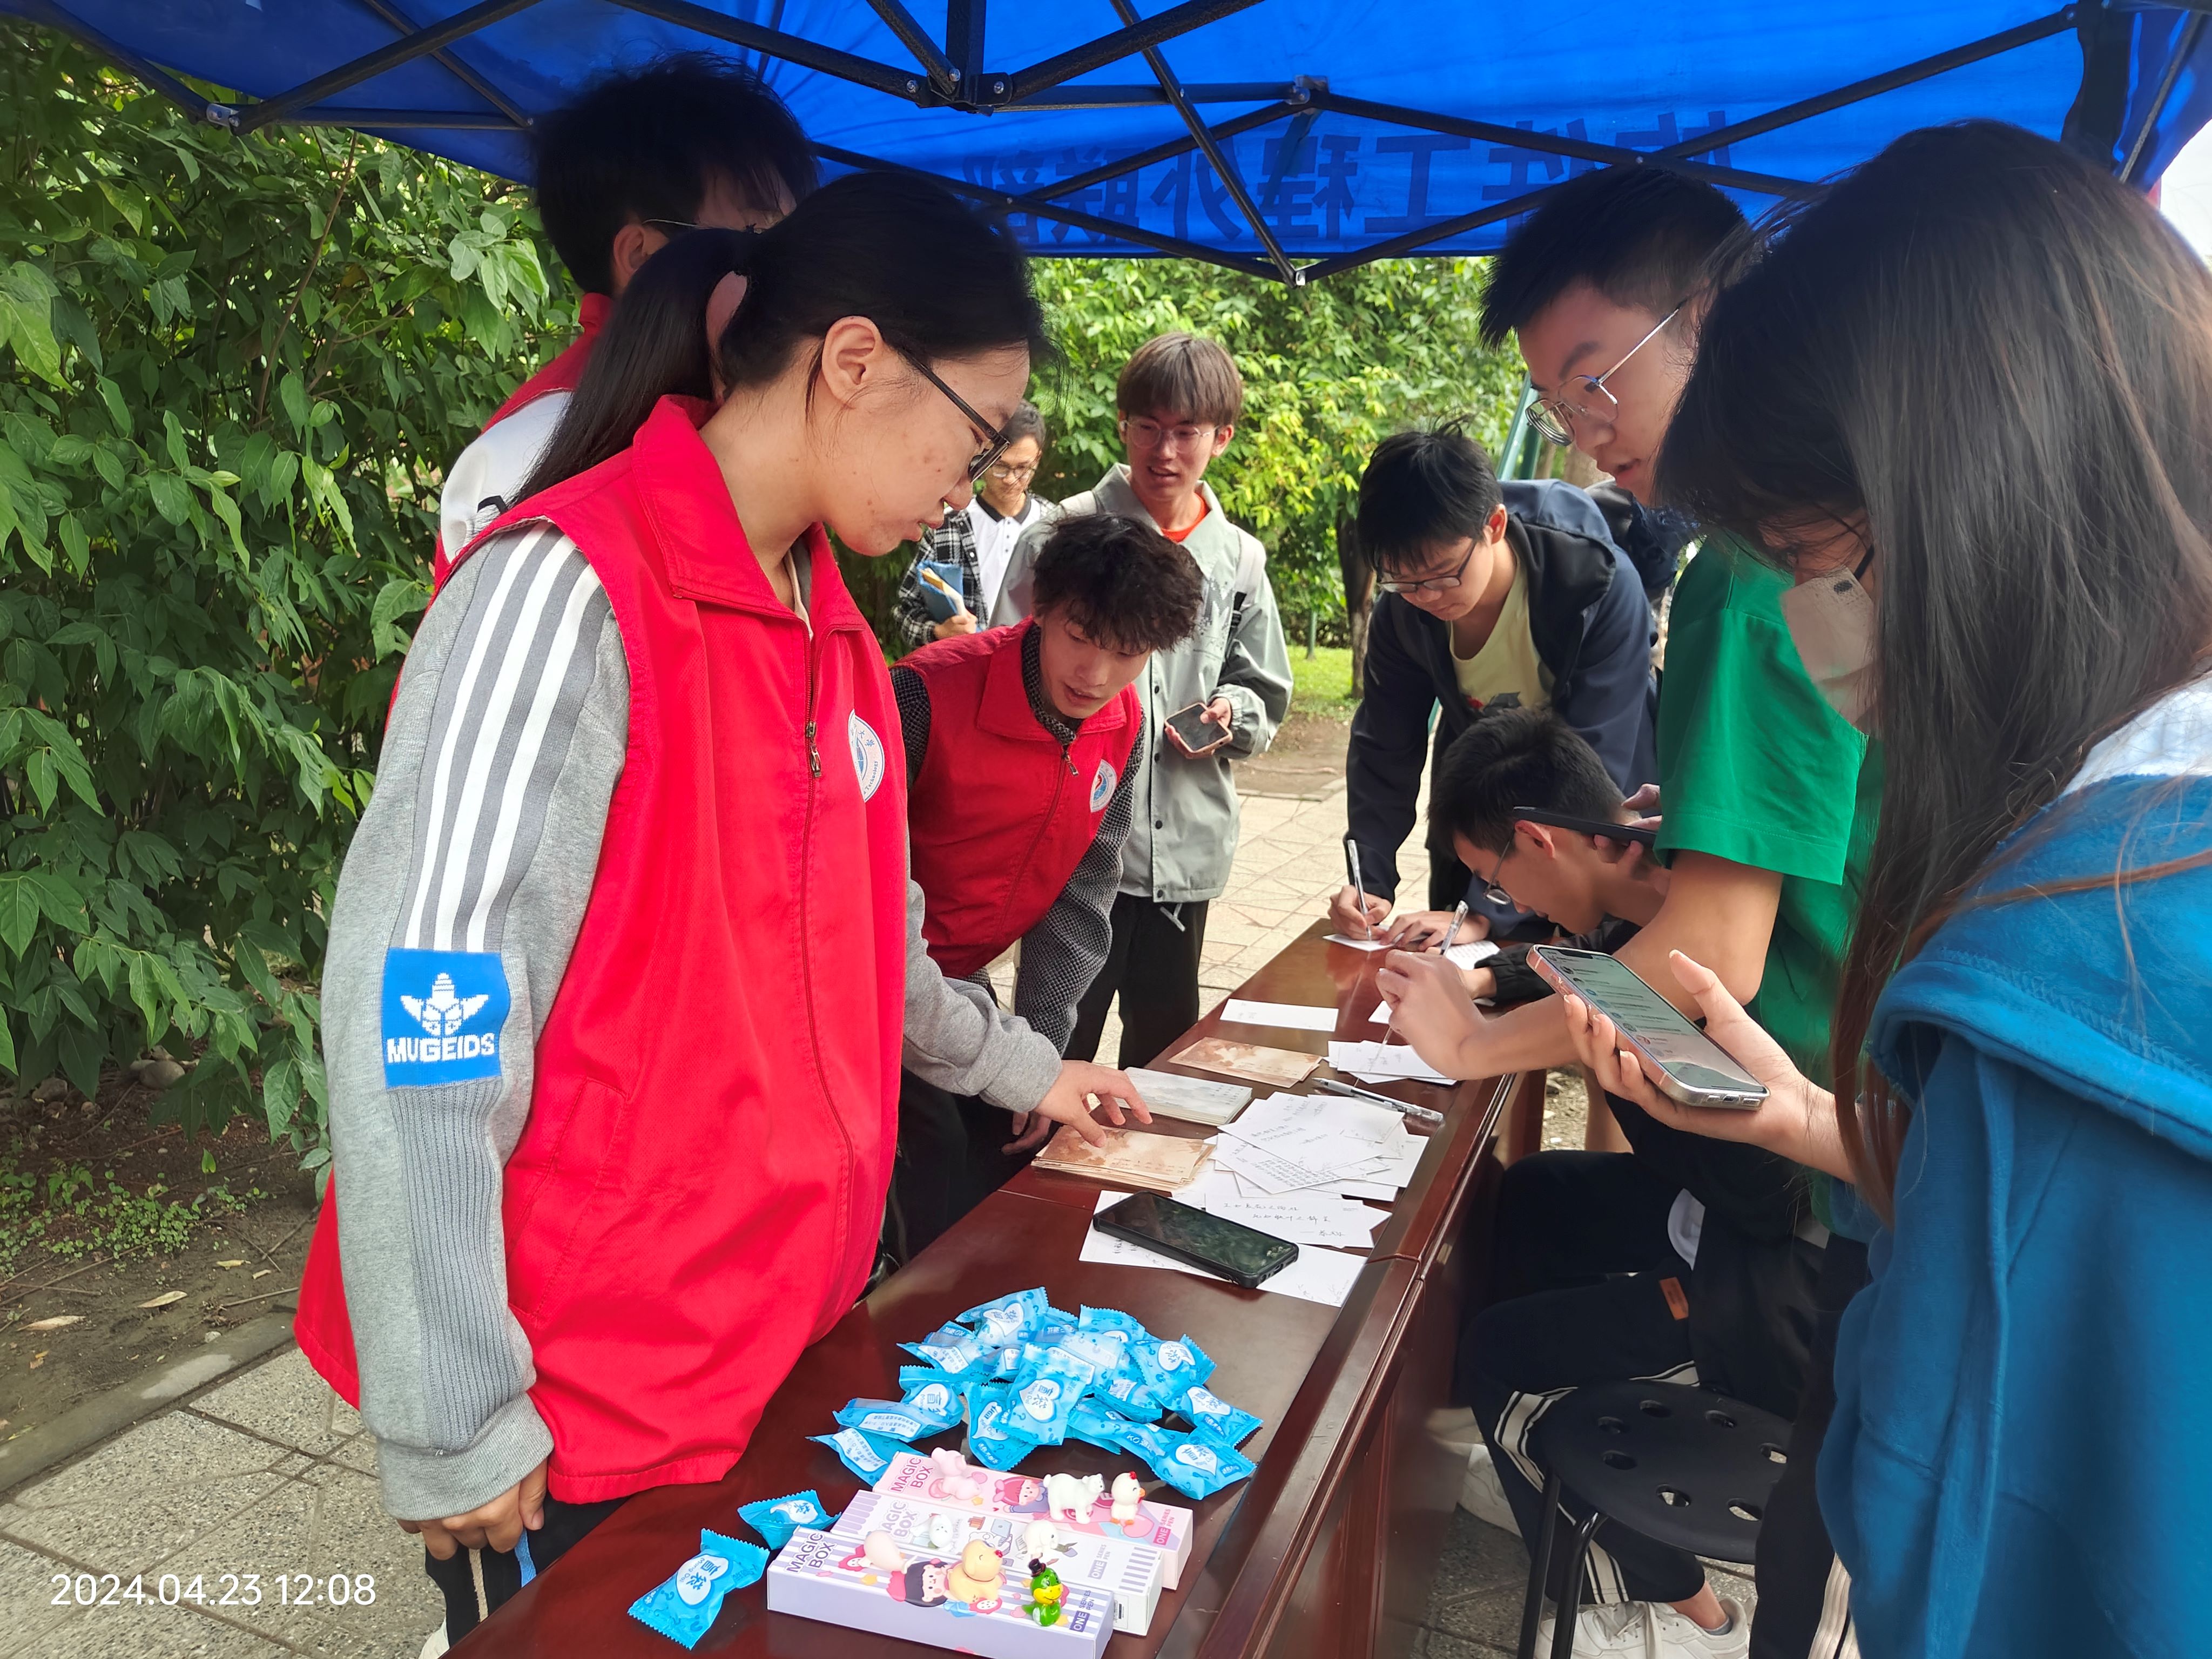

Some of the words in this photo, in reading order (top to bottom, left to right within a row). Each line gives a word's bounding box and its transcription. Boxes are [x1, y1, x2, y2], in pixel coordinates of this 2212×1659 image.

[866, 760, 879, 791] Technology
[387, 1033, 495, 1063] MUGEIDS
[890, 1458, 921, 1492] MAGIC
[910, 1466, 934, 1488] BOX
[881, 1501, 906, 1532] AGIC
[893, 1511, 918, 1537] BOX
[1156, 1527, 1166, 1544] ONE
[1161, 1508, 1171, 1526] SERIES
[786, 1533, 823, 1573] MAGIC
[807, 1543, 836, 1568] BOX
[1096, 1544, 1107, 1559] SERIES
[685, 1560, 721, 1590] 盲袋
[1091, 1560, 1103, 1577] ONE
[1079, 1589, 1091, 1609] SERIES
[1086, 1599, 1094, 1610] PEN
[1073, 1611, 1087, 1631] ONE
